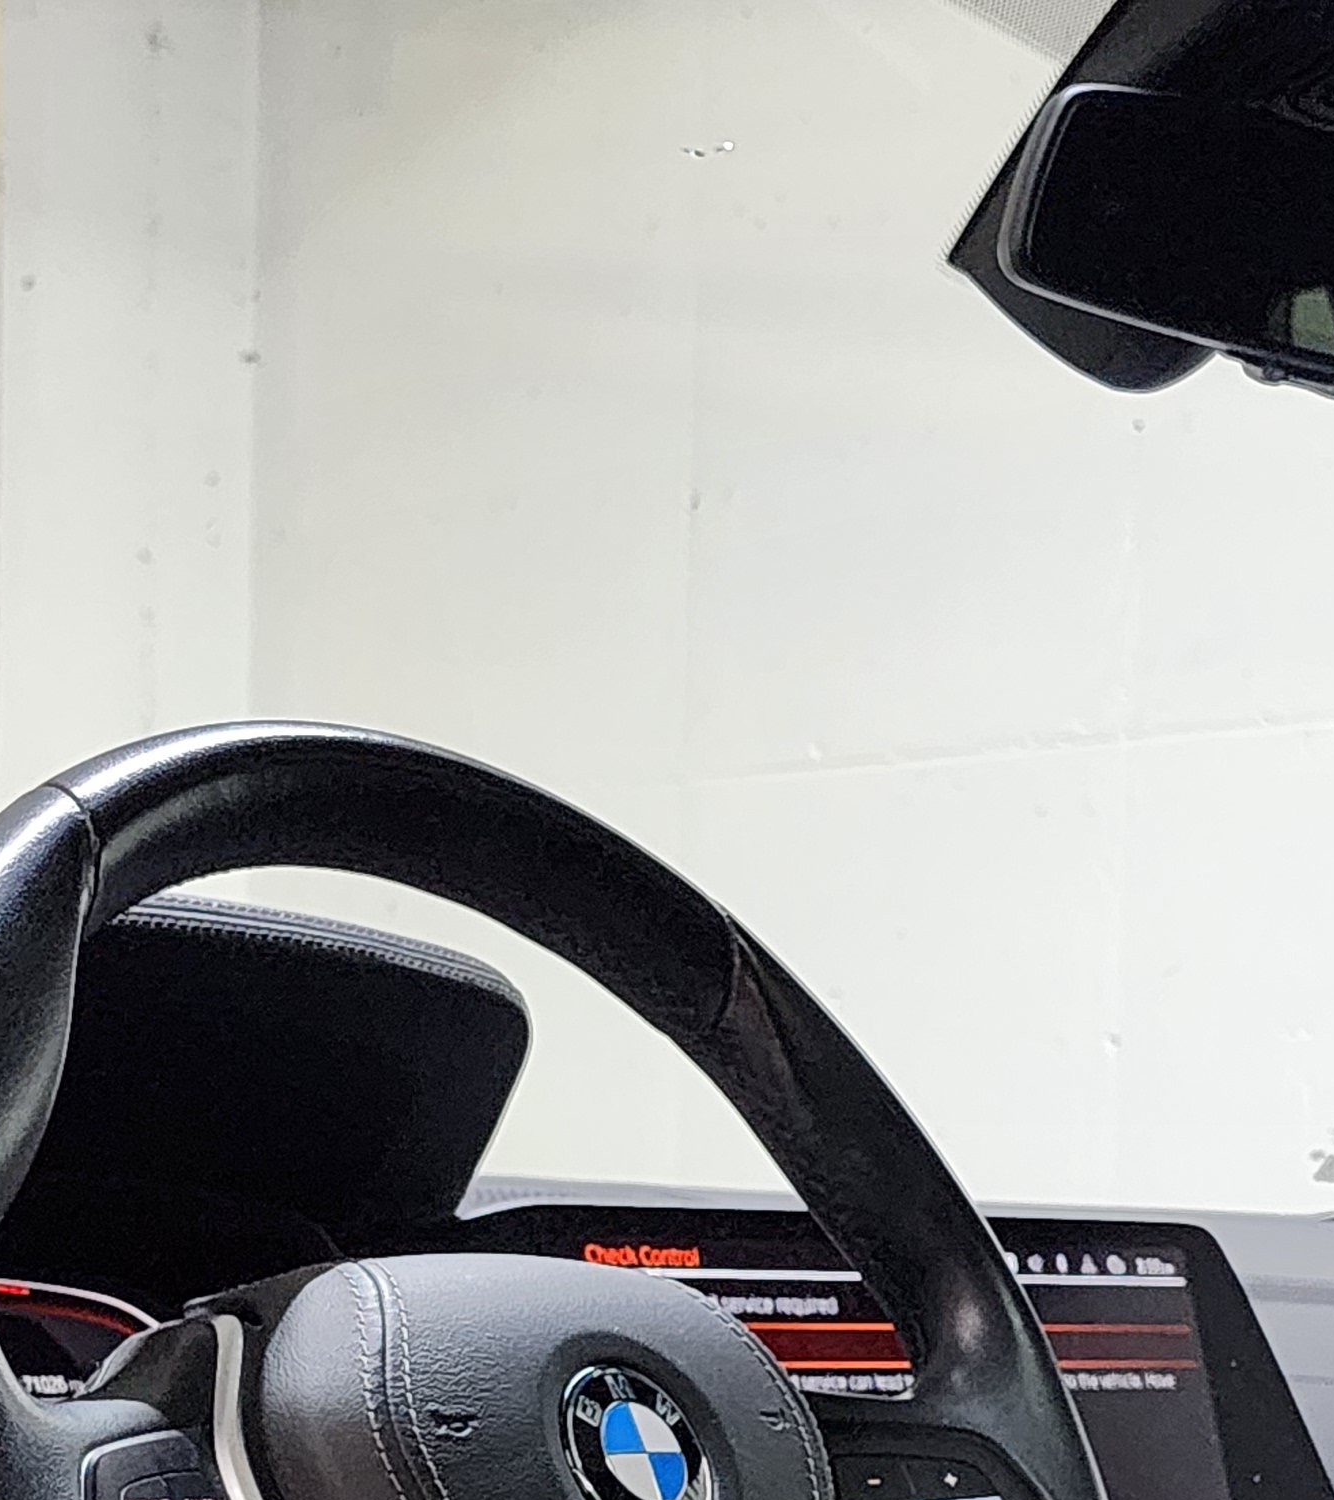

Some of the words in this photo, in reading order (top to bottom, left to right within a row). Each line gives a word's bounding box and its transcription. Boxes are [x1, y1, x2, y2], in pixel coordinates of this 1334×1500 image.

[584, 1243, 638, 1266] Check
[639, 1245, 701, 1267] Control
[576, 1375, 680, 1427] BMW
